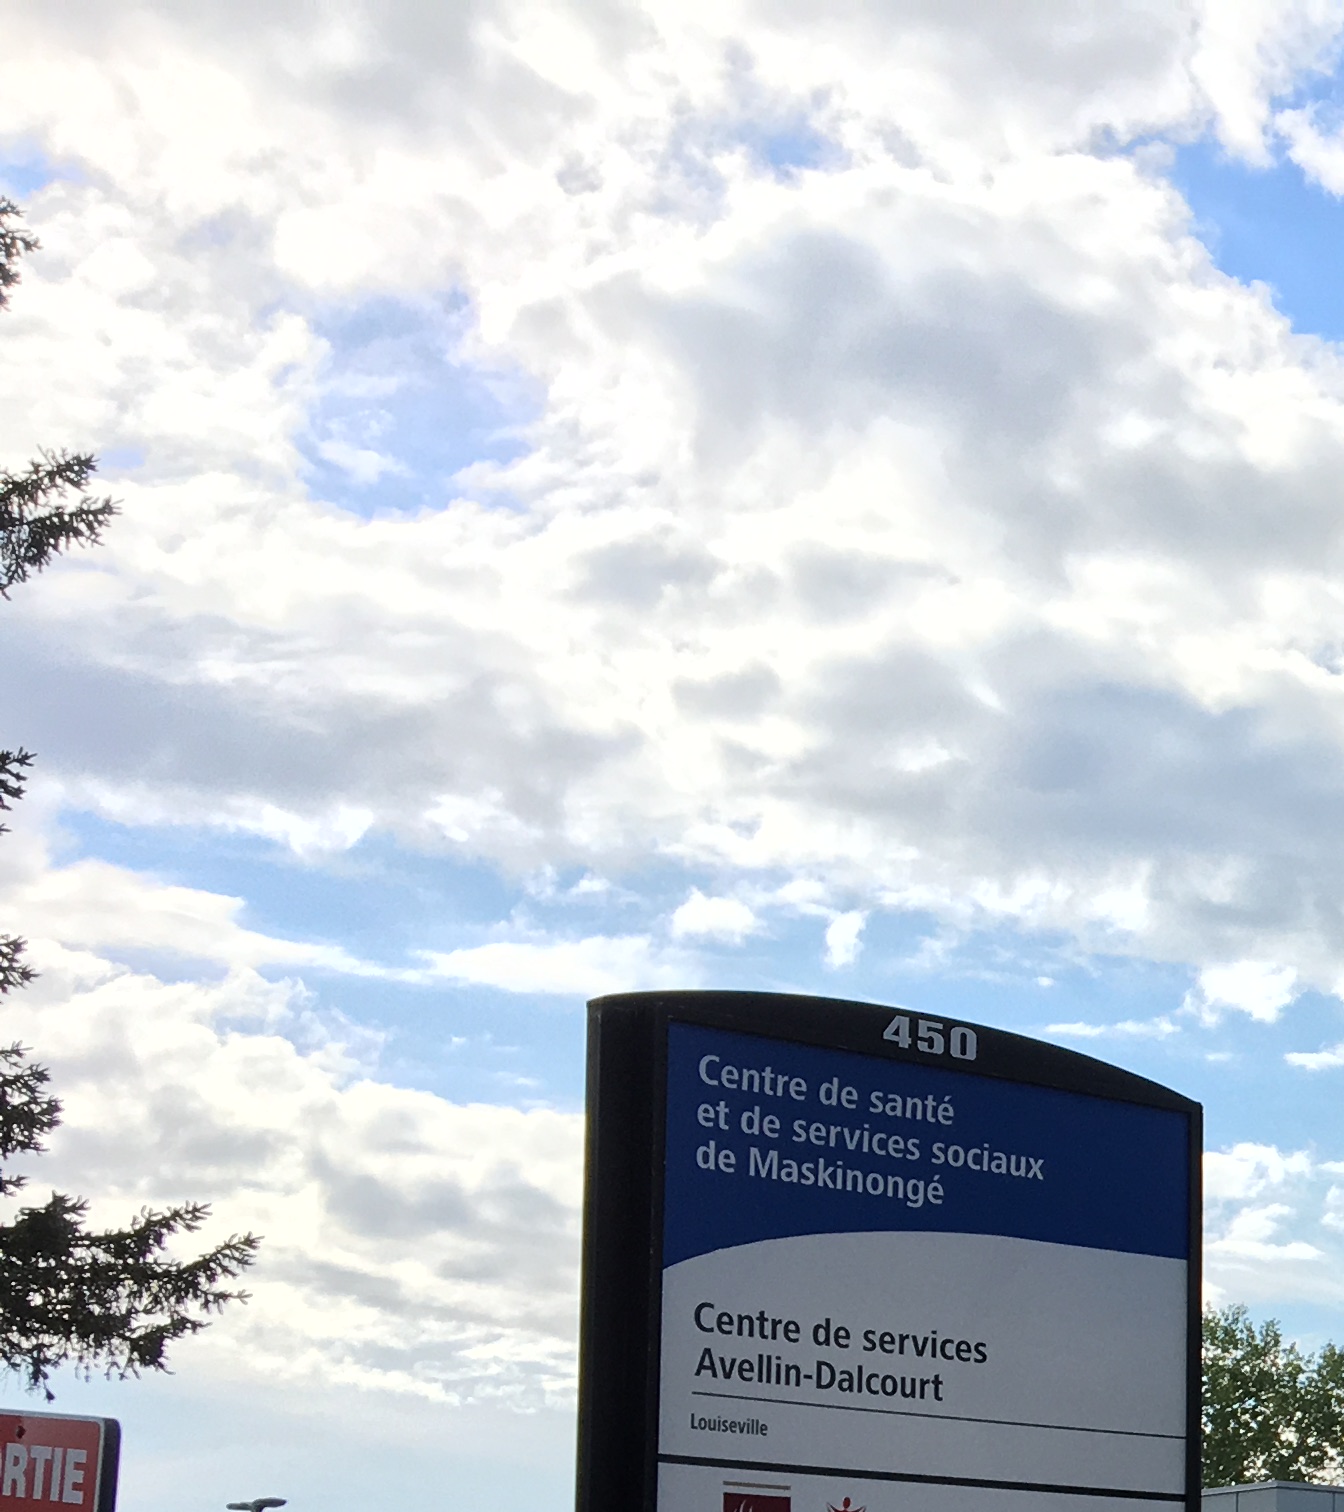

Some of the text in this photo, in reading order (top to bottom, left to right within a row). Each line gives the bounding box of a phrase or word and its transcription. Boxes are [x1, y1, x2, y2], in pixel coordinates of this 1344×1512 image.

[883, 1015, 978, 1061] 450
[699, 1054, 955, 1126] Centre de santé
[697, 1100, 1045, 1181] et de services sociaux
[696, 1140, 945, 1209] de Maskinongé
[694, 1302, 988, 1364] Centre de services
[694, 1347, 944, 1402] Avellin-Dalcourt
[690, 1413, 769, 1437] Louiseville
[0, 1442, 88, 1505] RTIE
